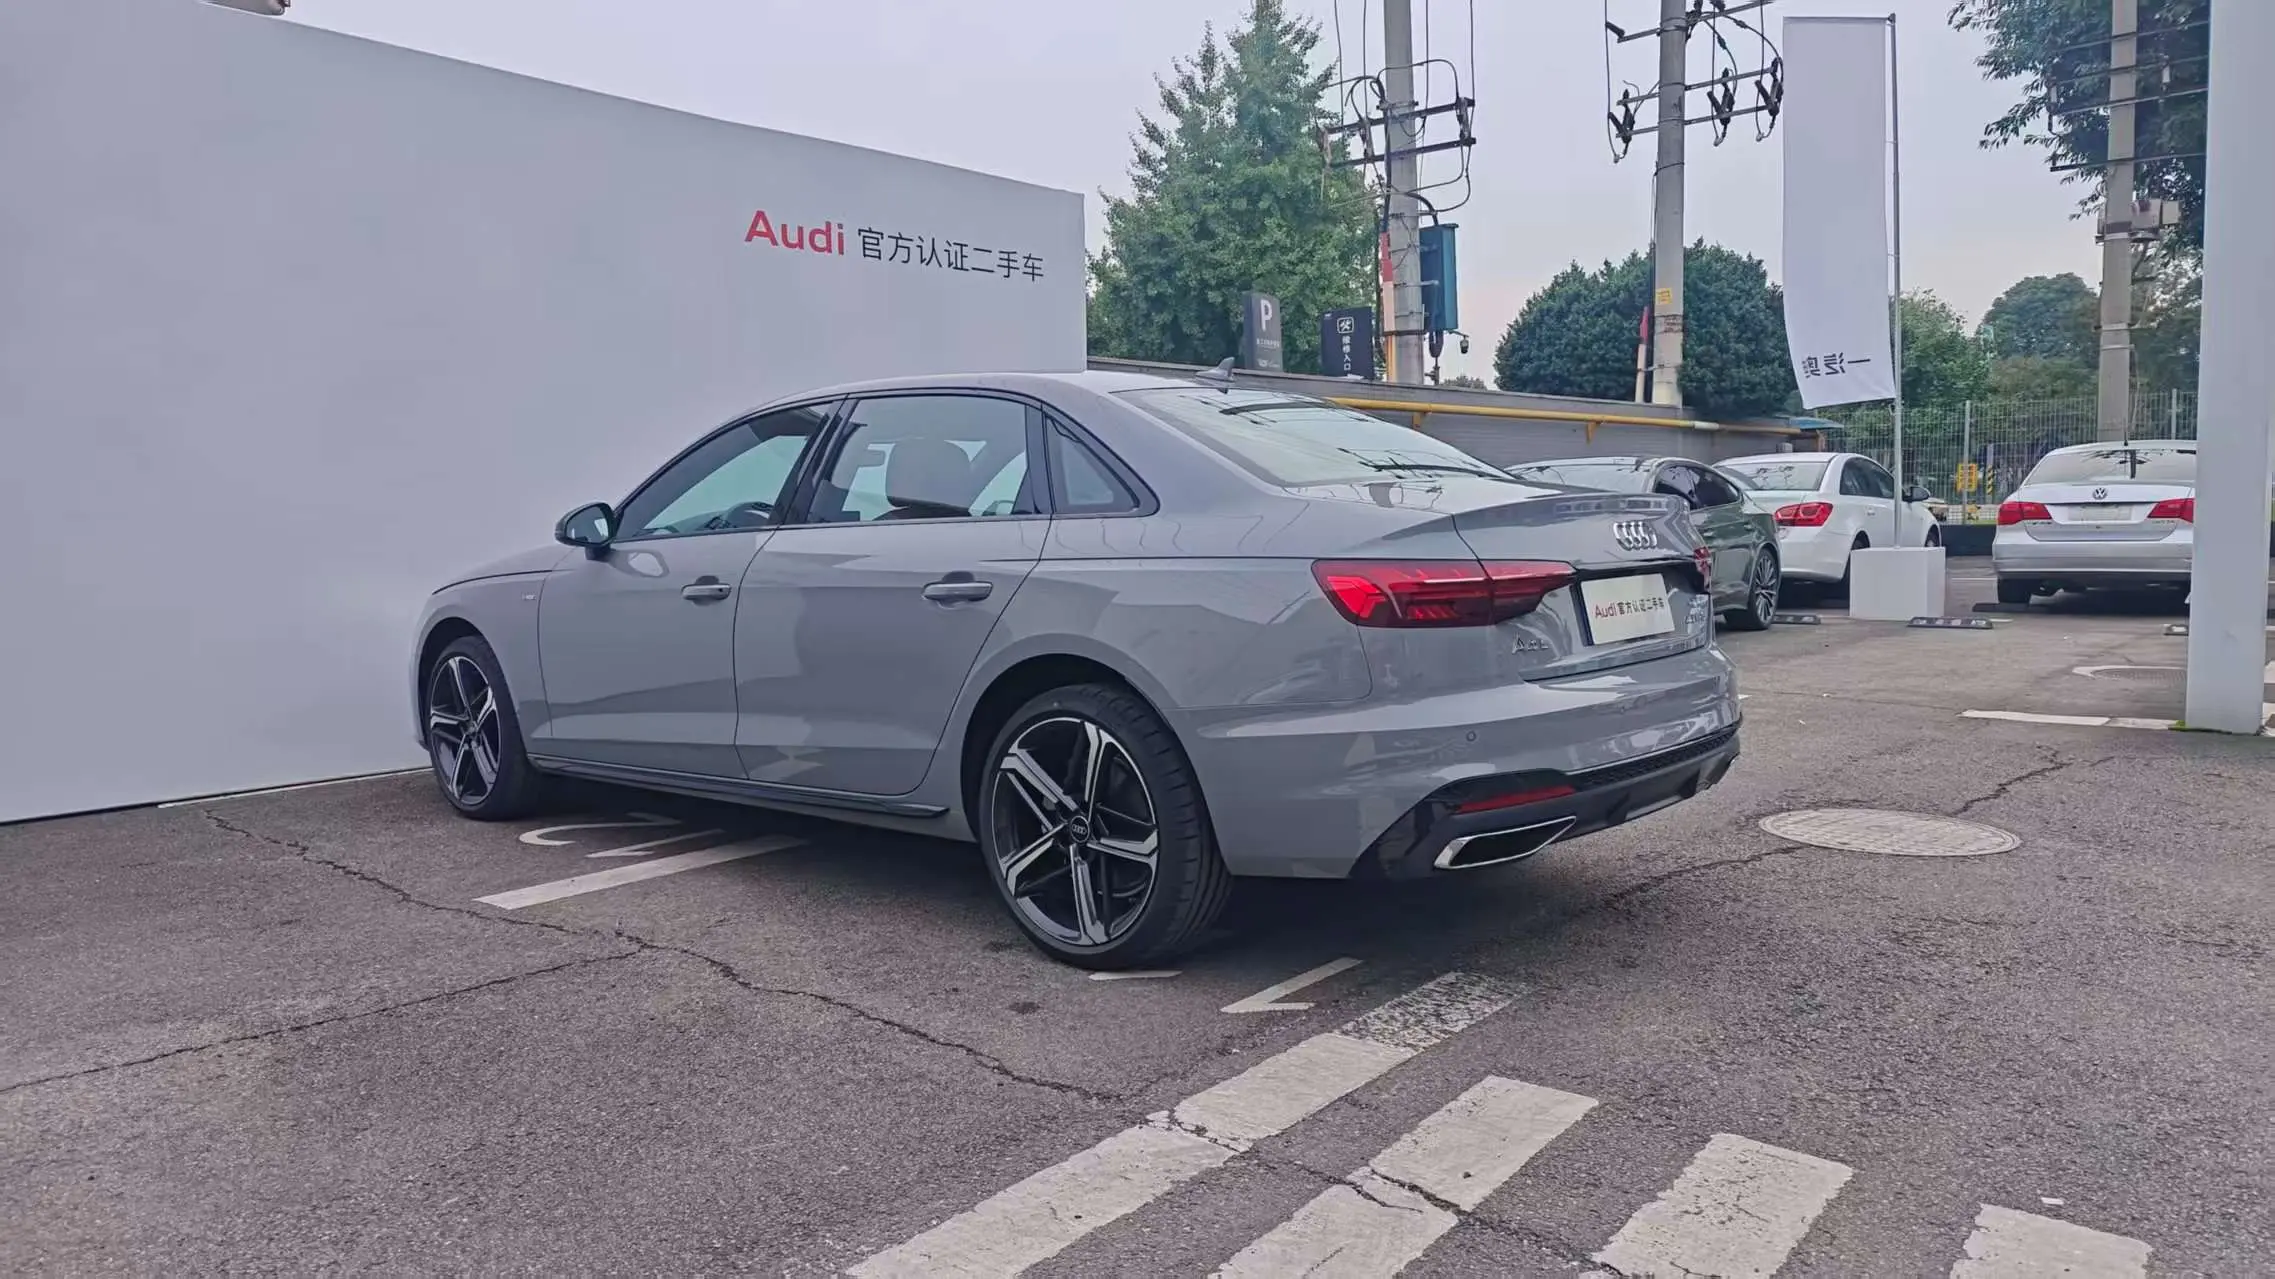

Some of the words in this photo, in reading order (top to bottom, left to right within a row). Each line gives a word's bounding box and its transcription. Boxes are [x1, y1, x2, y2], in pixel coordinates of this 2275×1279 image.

[744, 210, 844, 255] Audi
[858, 227, 1044, 282] 官方认证二手车
[1261, 299, 1272, 331] P
[1595, 603, 1617, 619] Audi
